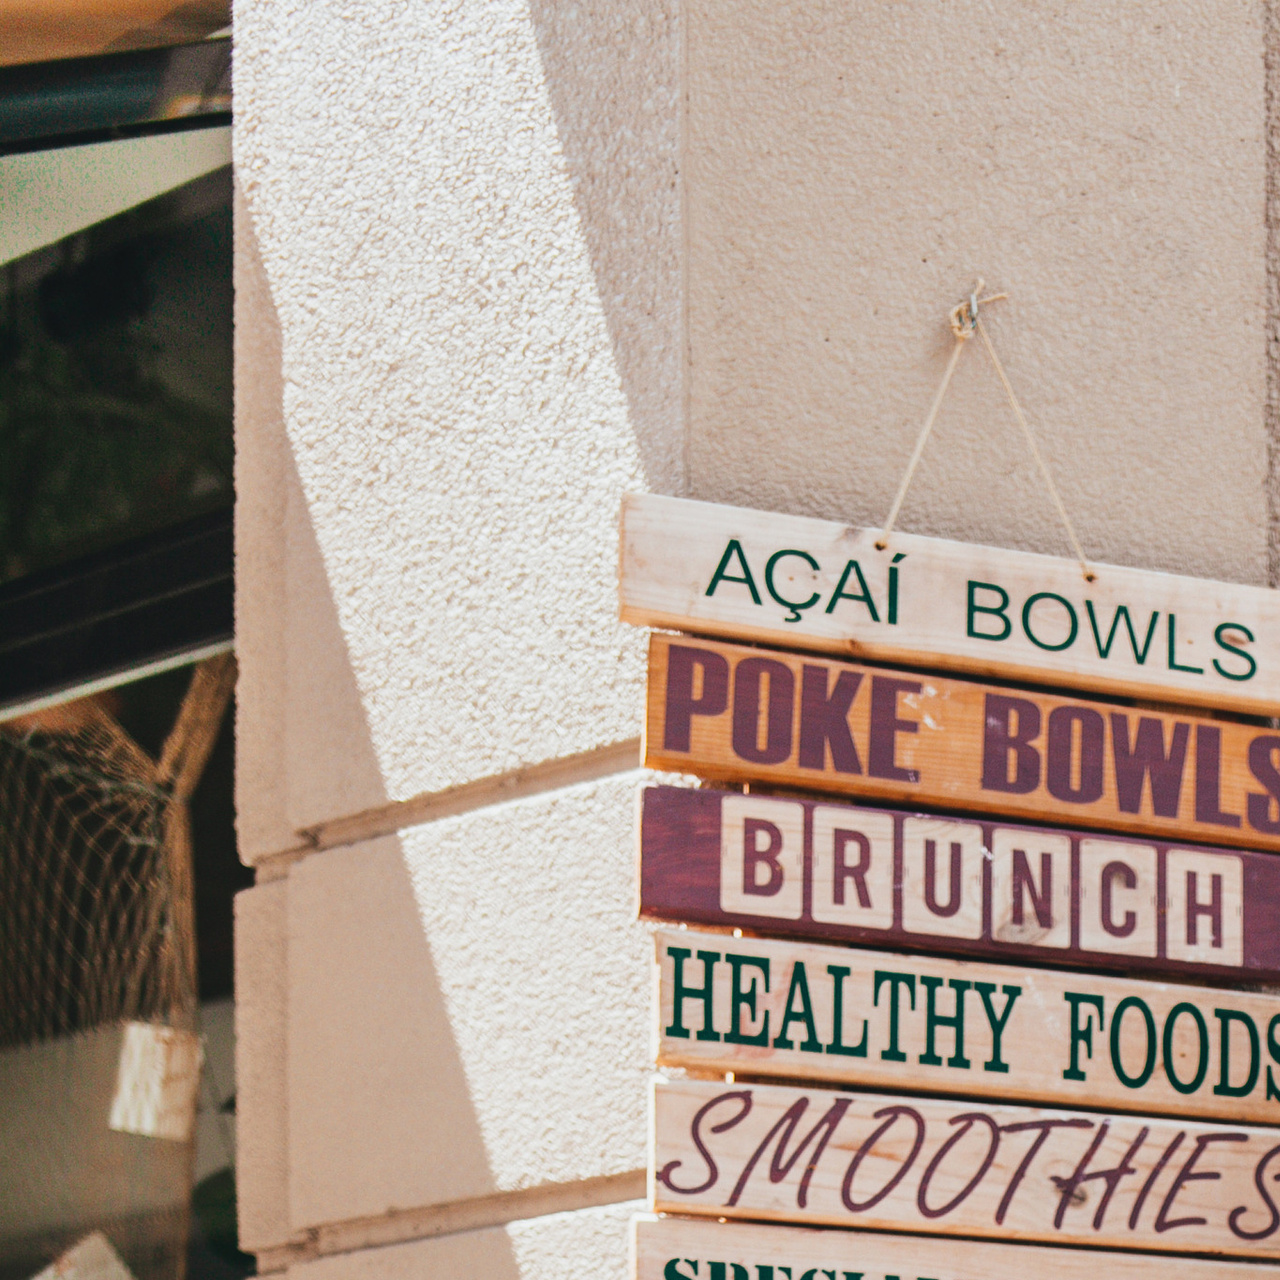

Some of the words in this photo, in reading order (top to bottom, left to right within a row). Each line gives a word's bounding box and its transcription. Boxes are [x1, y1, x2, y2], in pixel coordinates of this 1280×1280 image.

[705, 538, 907, 624] AÇAÍ
[965, 579, 1258, 681] BOWLS
[663, 645, 924, 783] POKE
[741, 818, 1224, 950] BRUNCH
[665, 946, 1022, 1074] HEALTHY
